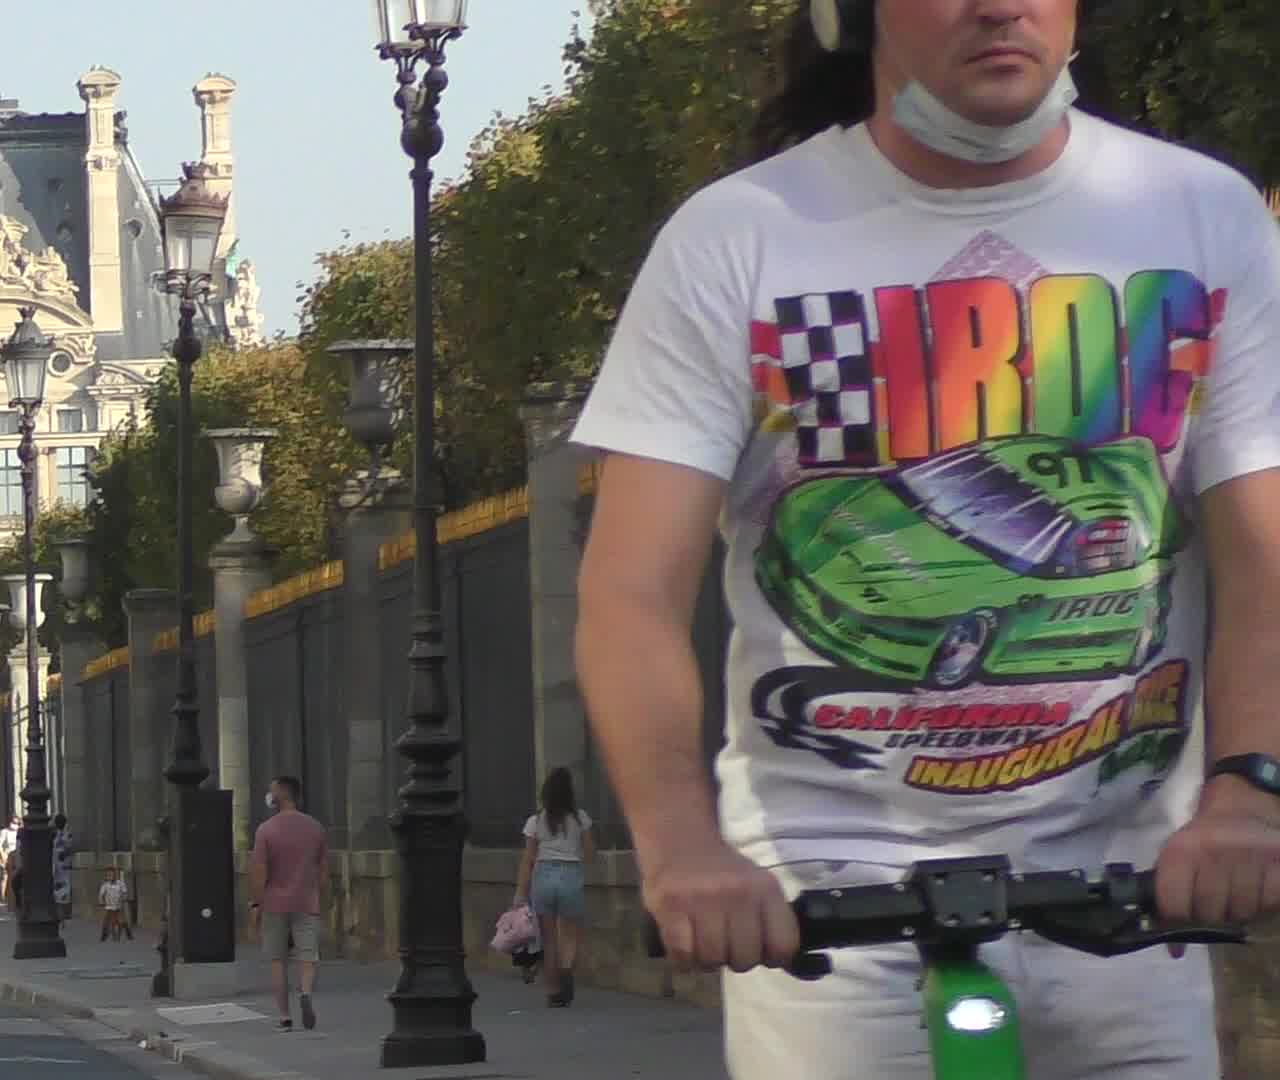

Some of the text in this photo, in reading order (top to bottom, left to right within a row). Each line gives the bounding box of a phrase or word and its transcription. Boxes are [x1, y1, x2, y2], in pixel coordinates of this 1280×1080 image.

[873, 269, 1209, 460] IROC
[1047, 591, 1140, 622] IROC
[814, 702, 1071, 729] CALIFORNIA
[886, 728, 1044, 748] SPEEDWAY
[910, 697, 1121, 788] INAUGURAL
